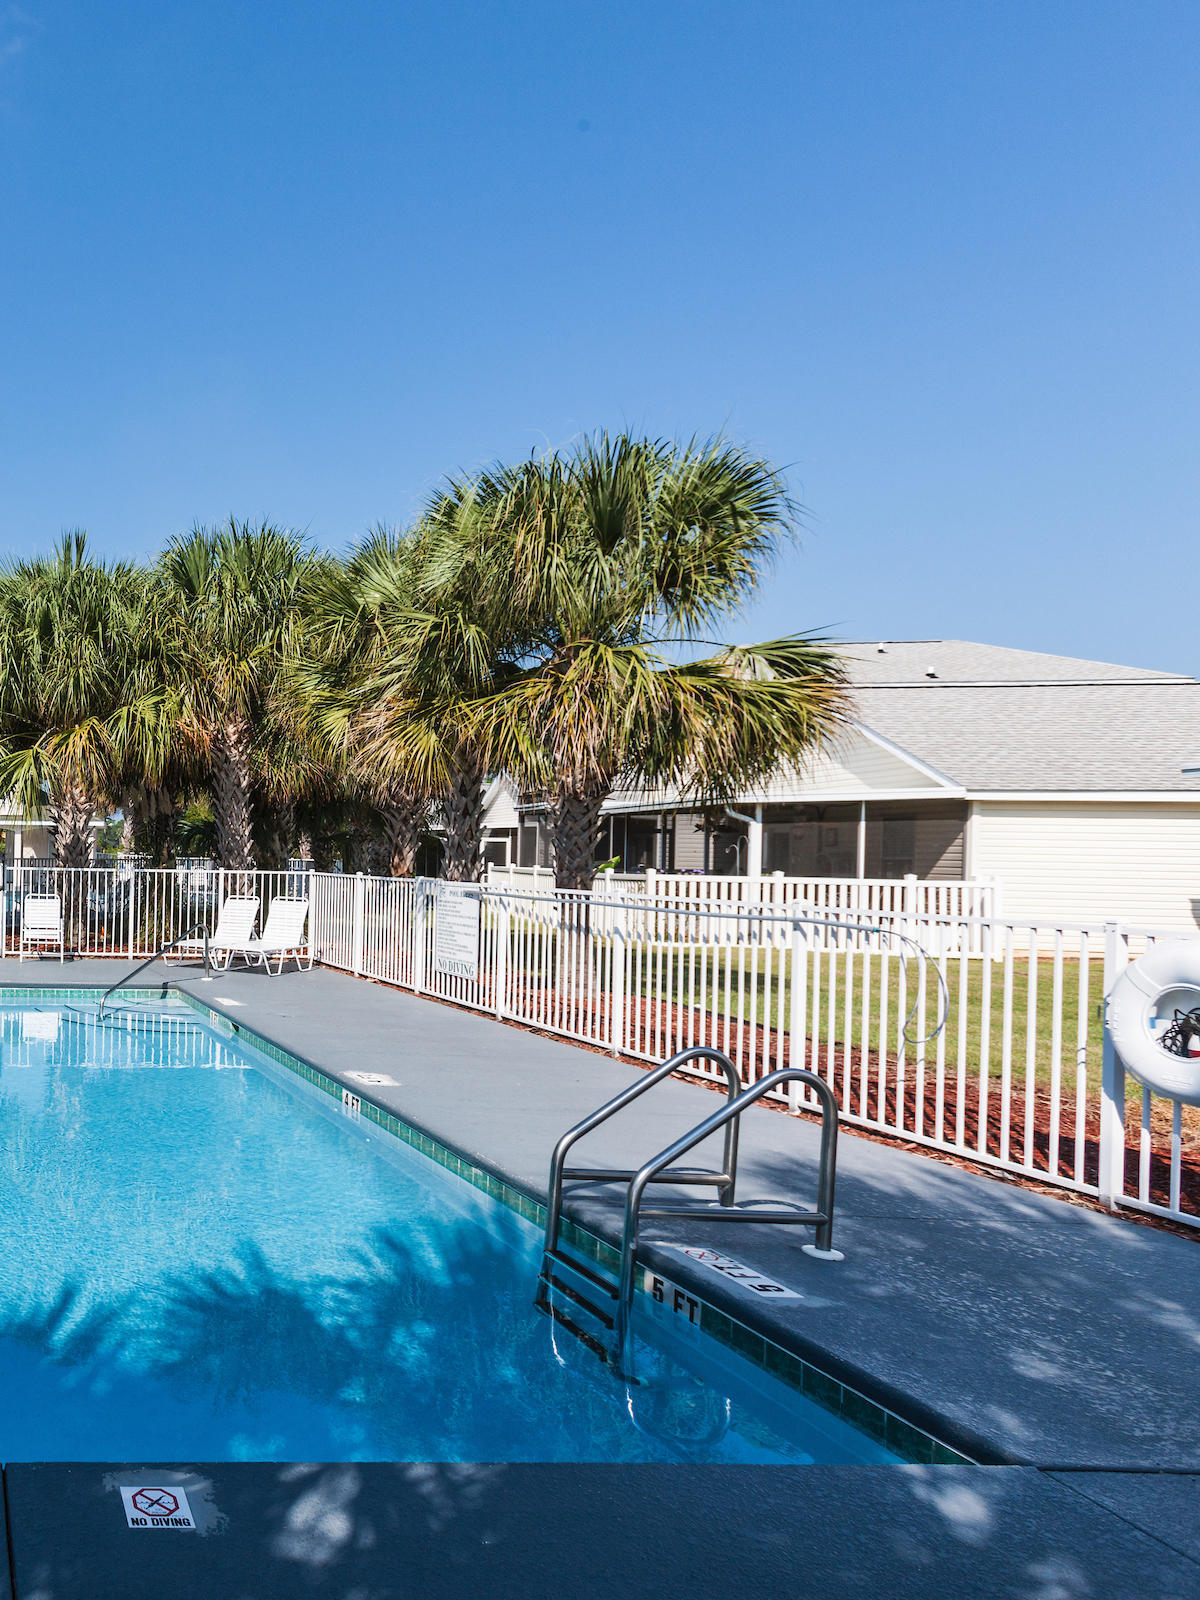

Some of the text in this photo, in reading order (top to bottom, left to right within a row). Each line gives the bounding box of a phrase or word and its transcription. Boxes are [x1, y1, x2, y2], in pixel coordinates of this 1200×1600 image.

[438, 958, 474, 977] NO DIVING
[344, 1093, 360, 1112] 4 FT
[712, 1263, 785, 1293] 5 FT
[652, 1276, 699, 1326] 5 FT
[130, 1517, 192, 1527] NO DIVING
